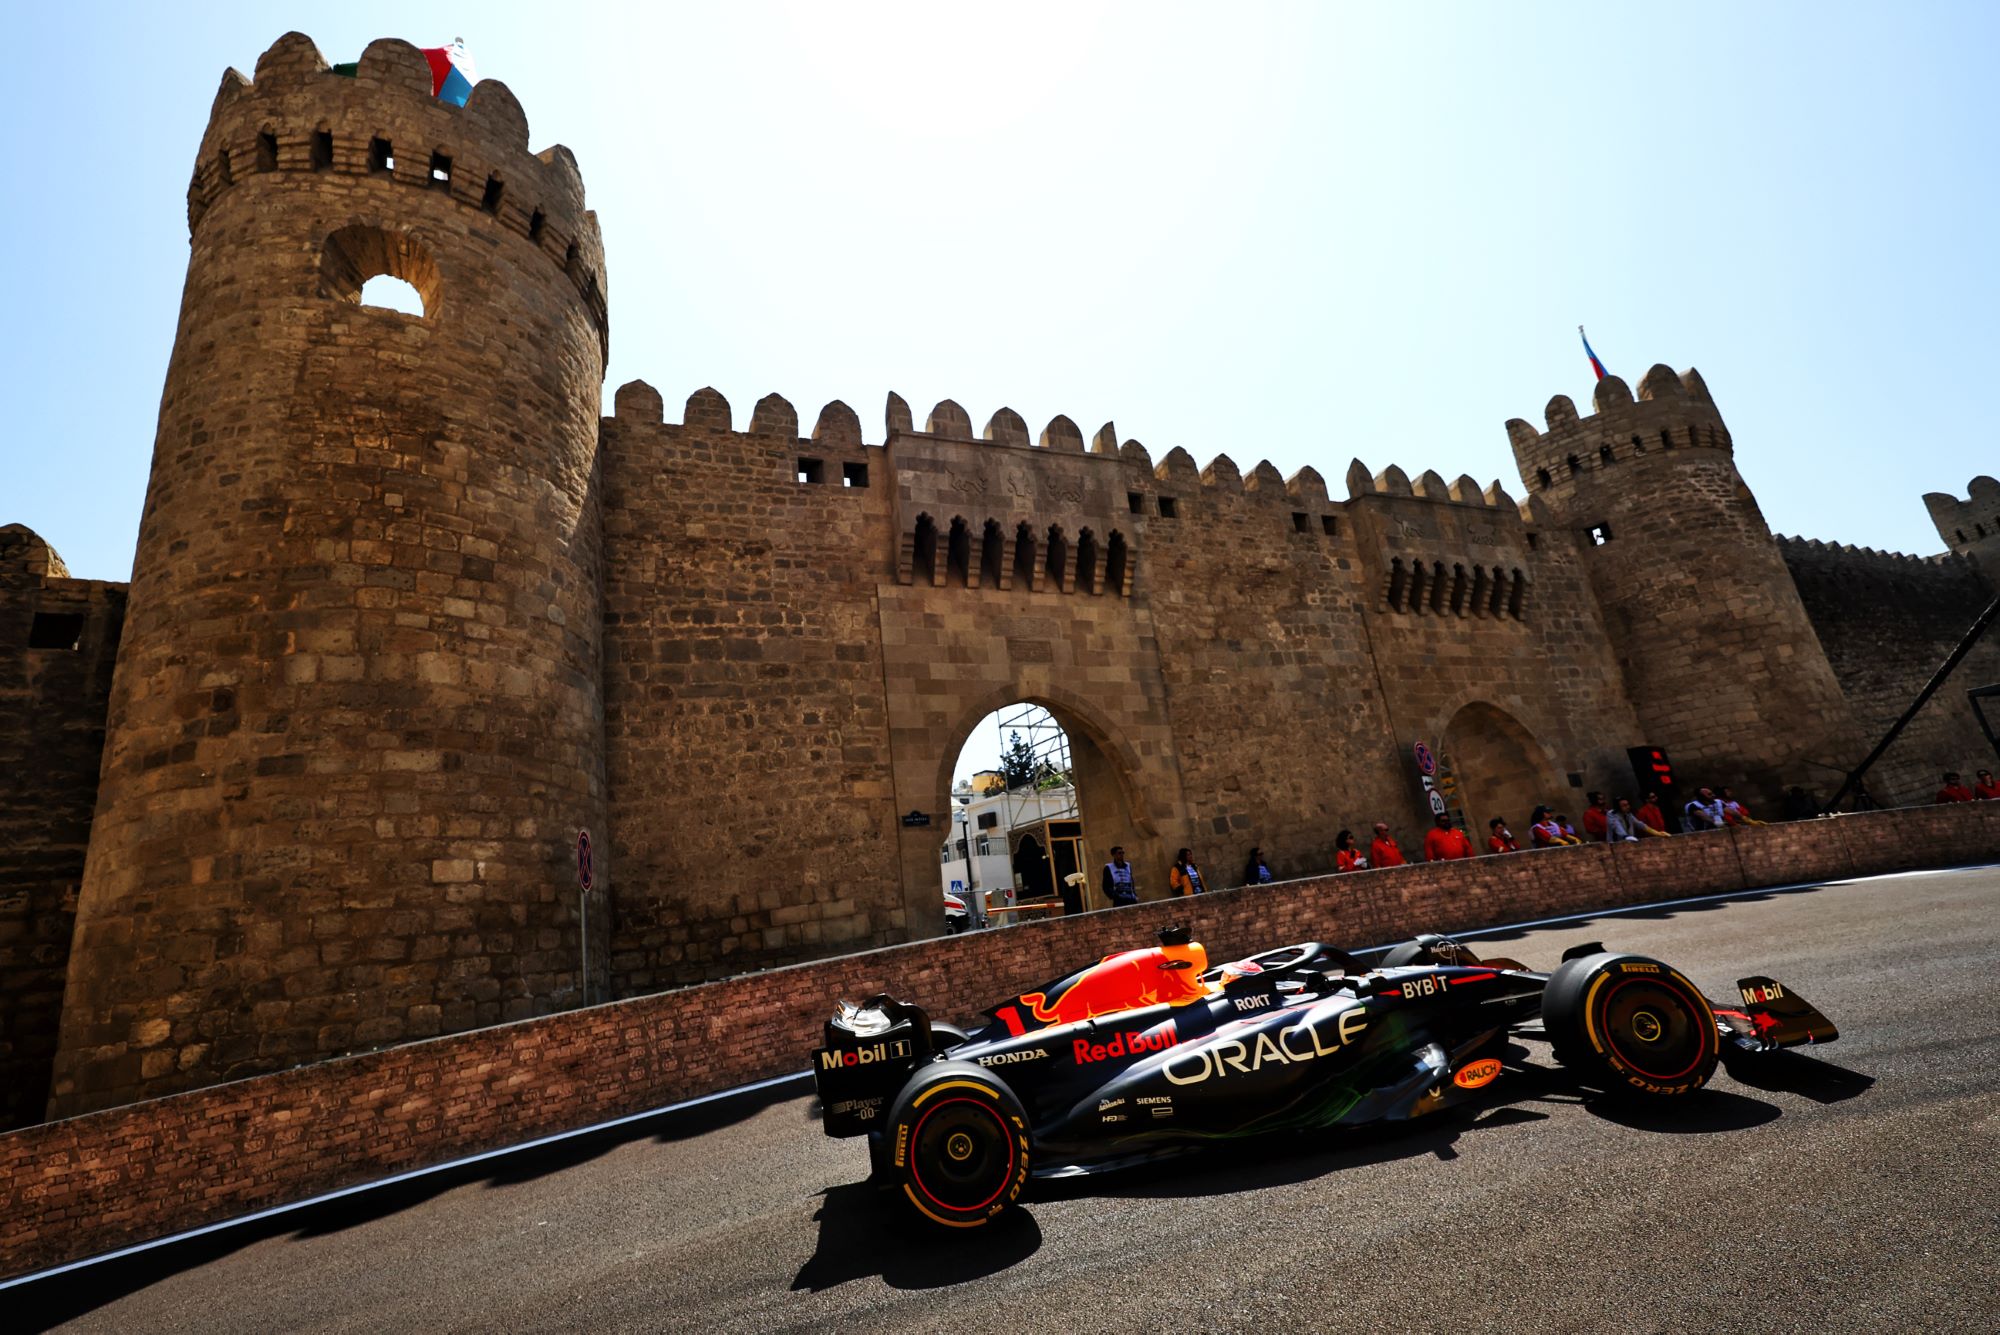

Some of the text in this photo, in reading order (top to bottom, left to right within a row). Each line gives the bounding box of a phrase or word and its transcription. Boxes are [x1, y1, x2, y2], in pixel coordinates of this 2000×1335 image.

[1432, 797, 1443, 811] 20
[1620, 962, 1660, 974] PIRELLI
[1402, 974, 1448, 999] BYBIT
[1742, 982, 1784, 1005] Mobil
[995, 1005, 1026, 1037] 1
[822, 1042, 904, 1070] Mobil 1
[977, 1048, 1051, 1067] HONDA
[1073, 1026, 1178, 1065] Red Bull
[1161, 1007, 1369, 1086] ORACLE
[1466, 1062, 1497, 1082] RAUCH
[1628, 1076, 1689, 1095] ZERO
[1136, 1096, 1173, 1106] SIEMENS
[894, 1123, 909, 1168] PIRELLI
[1009, 1134, 1029, 1201] ZERO
